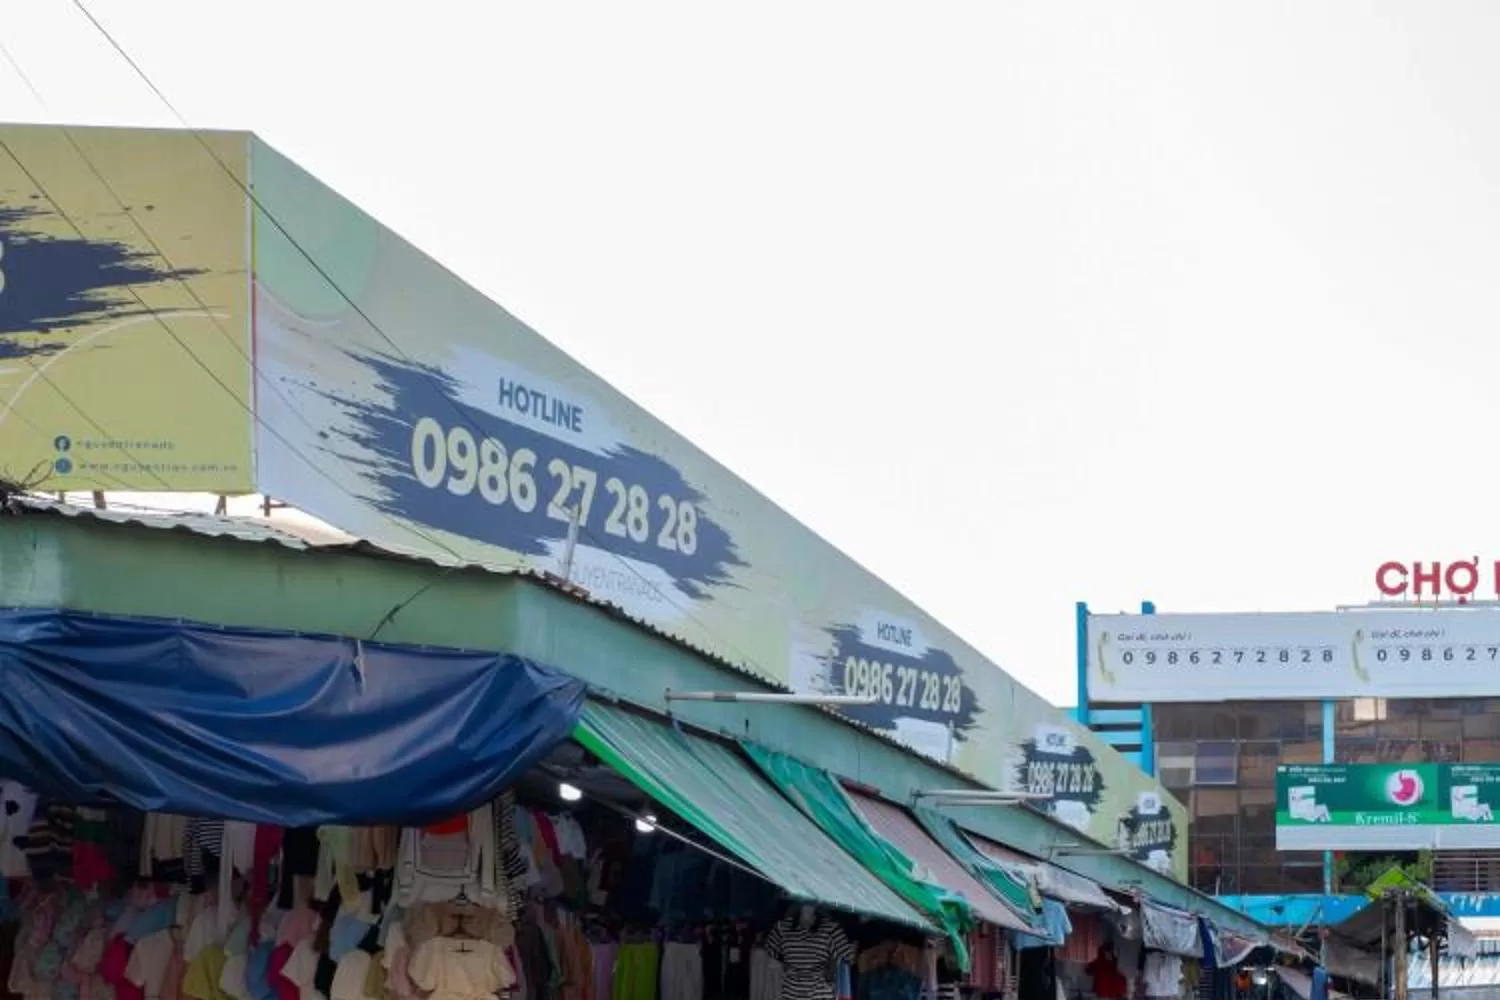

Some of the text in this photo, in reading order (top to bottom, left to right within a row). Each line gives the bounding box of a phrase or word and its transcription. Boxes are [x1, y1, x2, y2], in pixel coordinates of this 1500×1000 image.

[499, 378, 585, 433] HOTLINE
[412, 416, 698, 556] 0986 27 28 28
[1376, 555, 1480, 604] CHỢ
[844, 655, 962, 714] 0986 27 28 28
